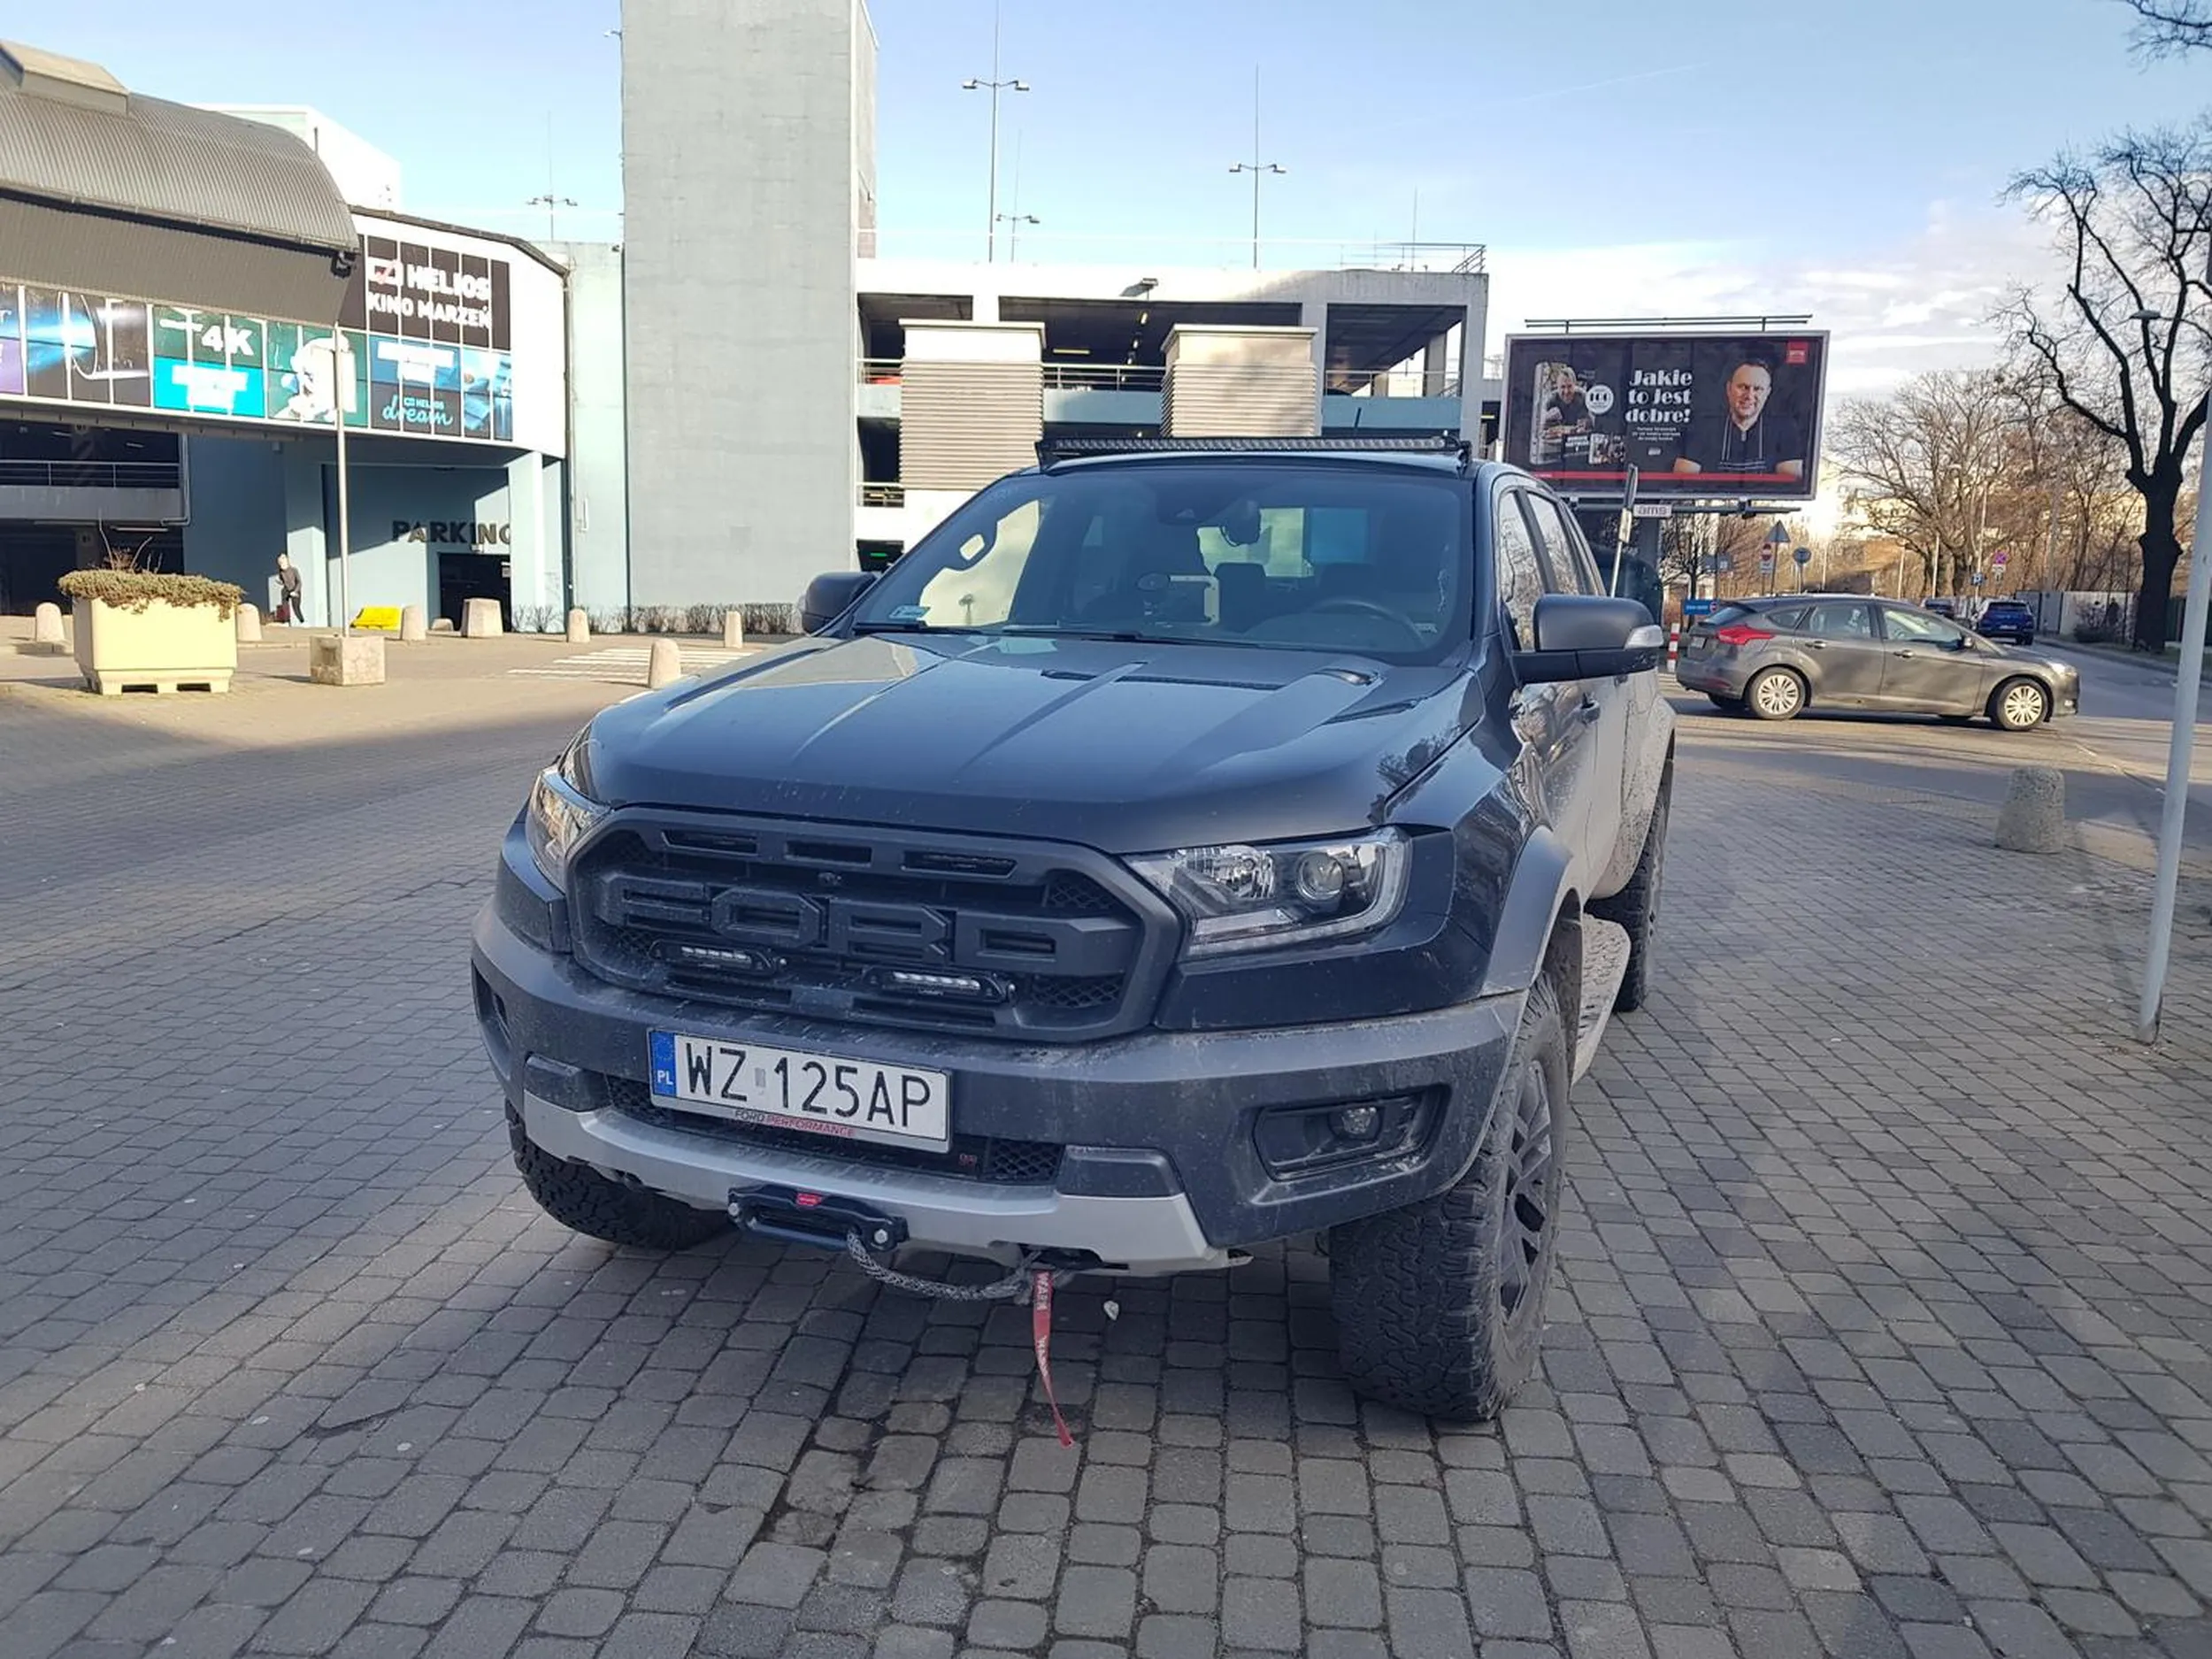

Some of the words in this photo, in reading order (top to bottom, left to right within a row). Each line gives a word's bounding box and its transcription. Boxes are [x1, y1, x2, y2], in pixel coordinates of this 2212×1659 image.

[407, 264, 489, 301] HELIOS
[367, 292, 414, 317] KINO
[417, 298, 492, 329] MARZEŃ
[201, 324, 254, 356] 4K
[1629, 368, 1693, 387] Jakie
[381, 395, 453, 426] dream
[1628, 388, 1649, 405] to
[1624, 408, 1691, 423] dobre!
[1638, 505, 1668, 515] ams
[600, 872, 1142, 975] FORD
[657, 1069, 673, 1087] PL
[686, 1042, 748, 1102] WZ
[773, 1056, 931, 1127] 125AP
[734, 1110, 765, 1123] FORD
[766, 1114, 857, 1137] PERFORMANCE
